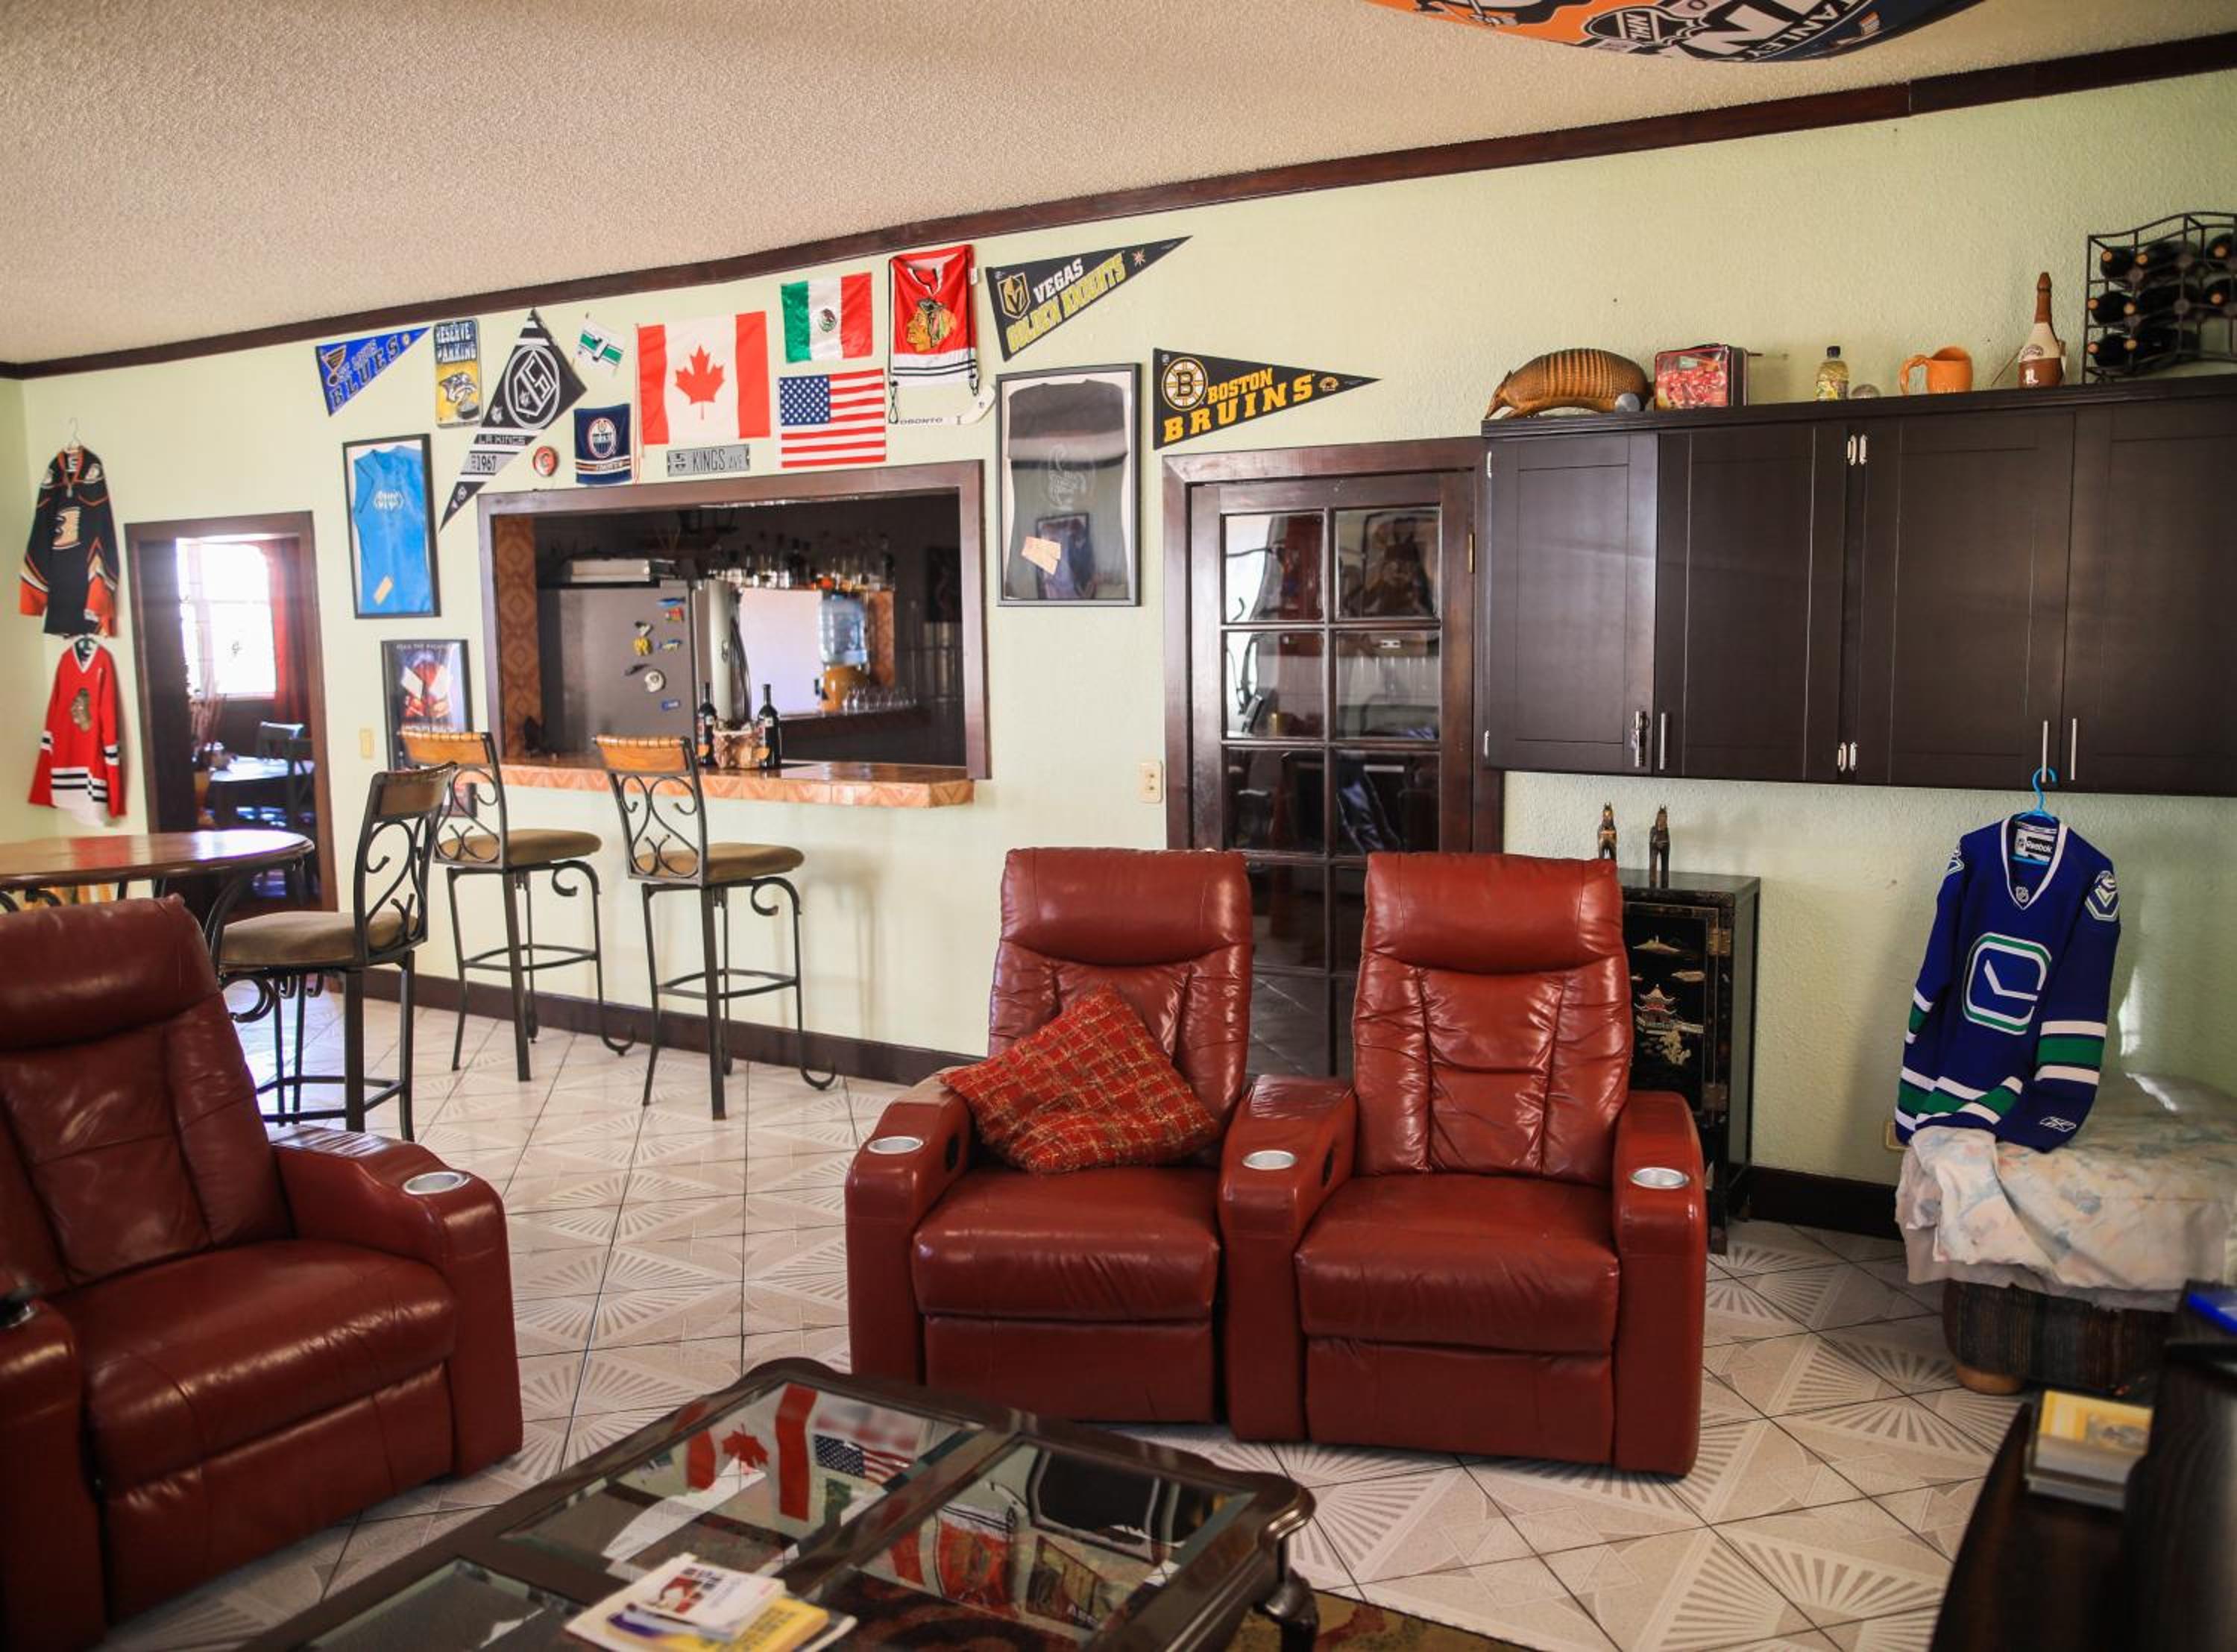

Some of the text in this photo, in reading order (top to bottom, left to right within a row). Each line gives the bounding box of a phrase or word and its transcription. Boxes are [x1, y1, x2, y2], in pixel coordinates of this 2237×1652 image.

[1625, 13, 1652, 39] NHL
[1033, 258, 1083, 303] VEGAS
[437, 341, 476, 362] PARKING
[330, 335, 398, 408] BLUES
[1208, 368, 1273, 405] BOSTON
[890, 416, 943, 425] ORONTO
[1164, 373, 1313, 444] BRUINS
[476, 454, 497, 470] 1967
[692, 449, 726, 471] KINGS
[2026, 839, 2053, 853] Reebok
